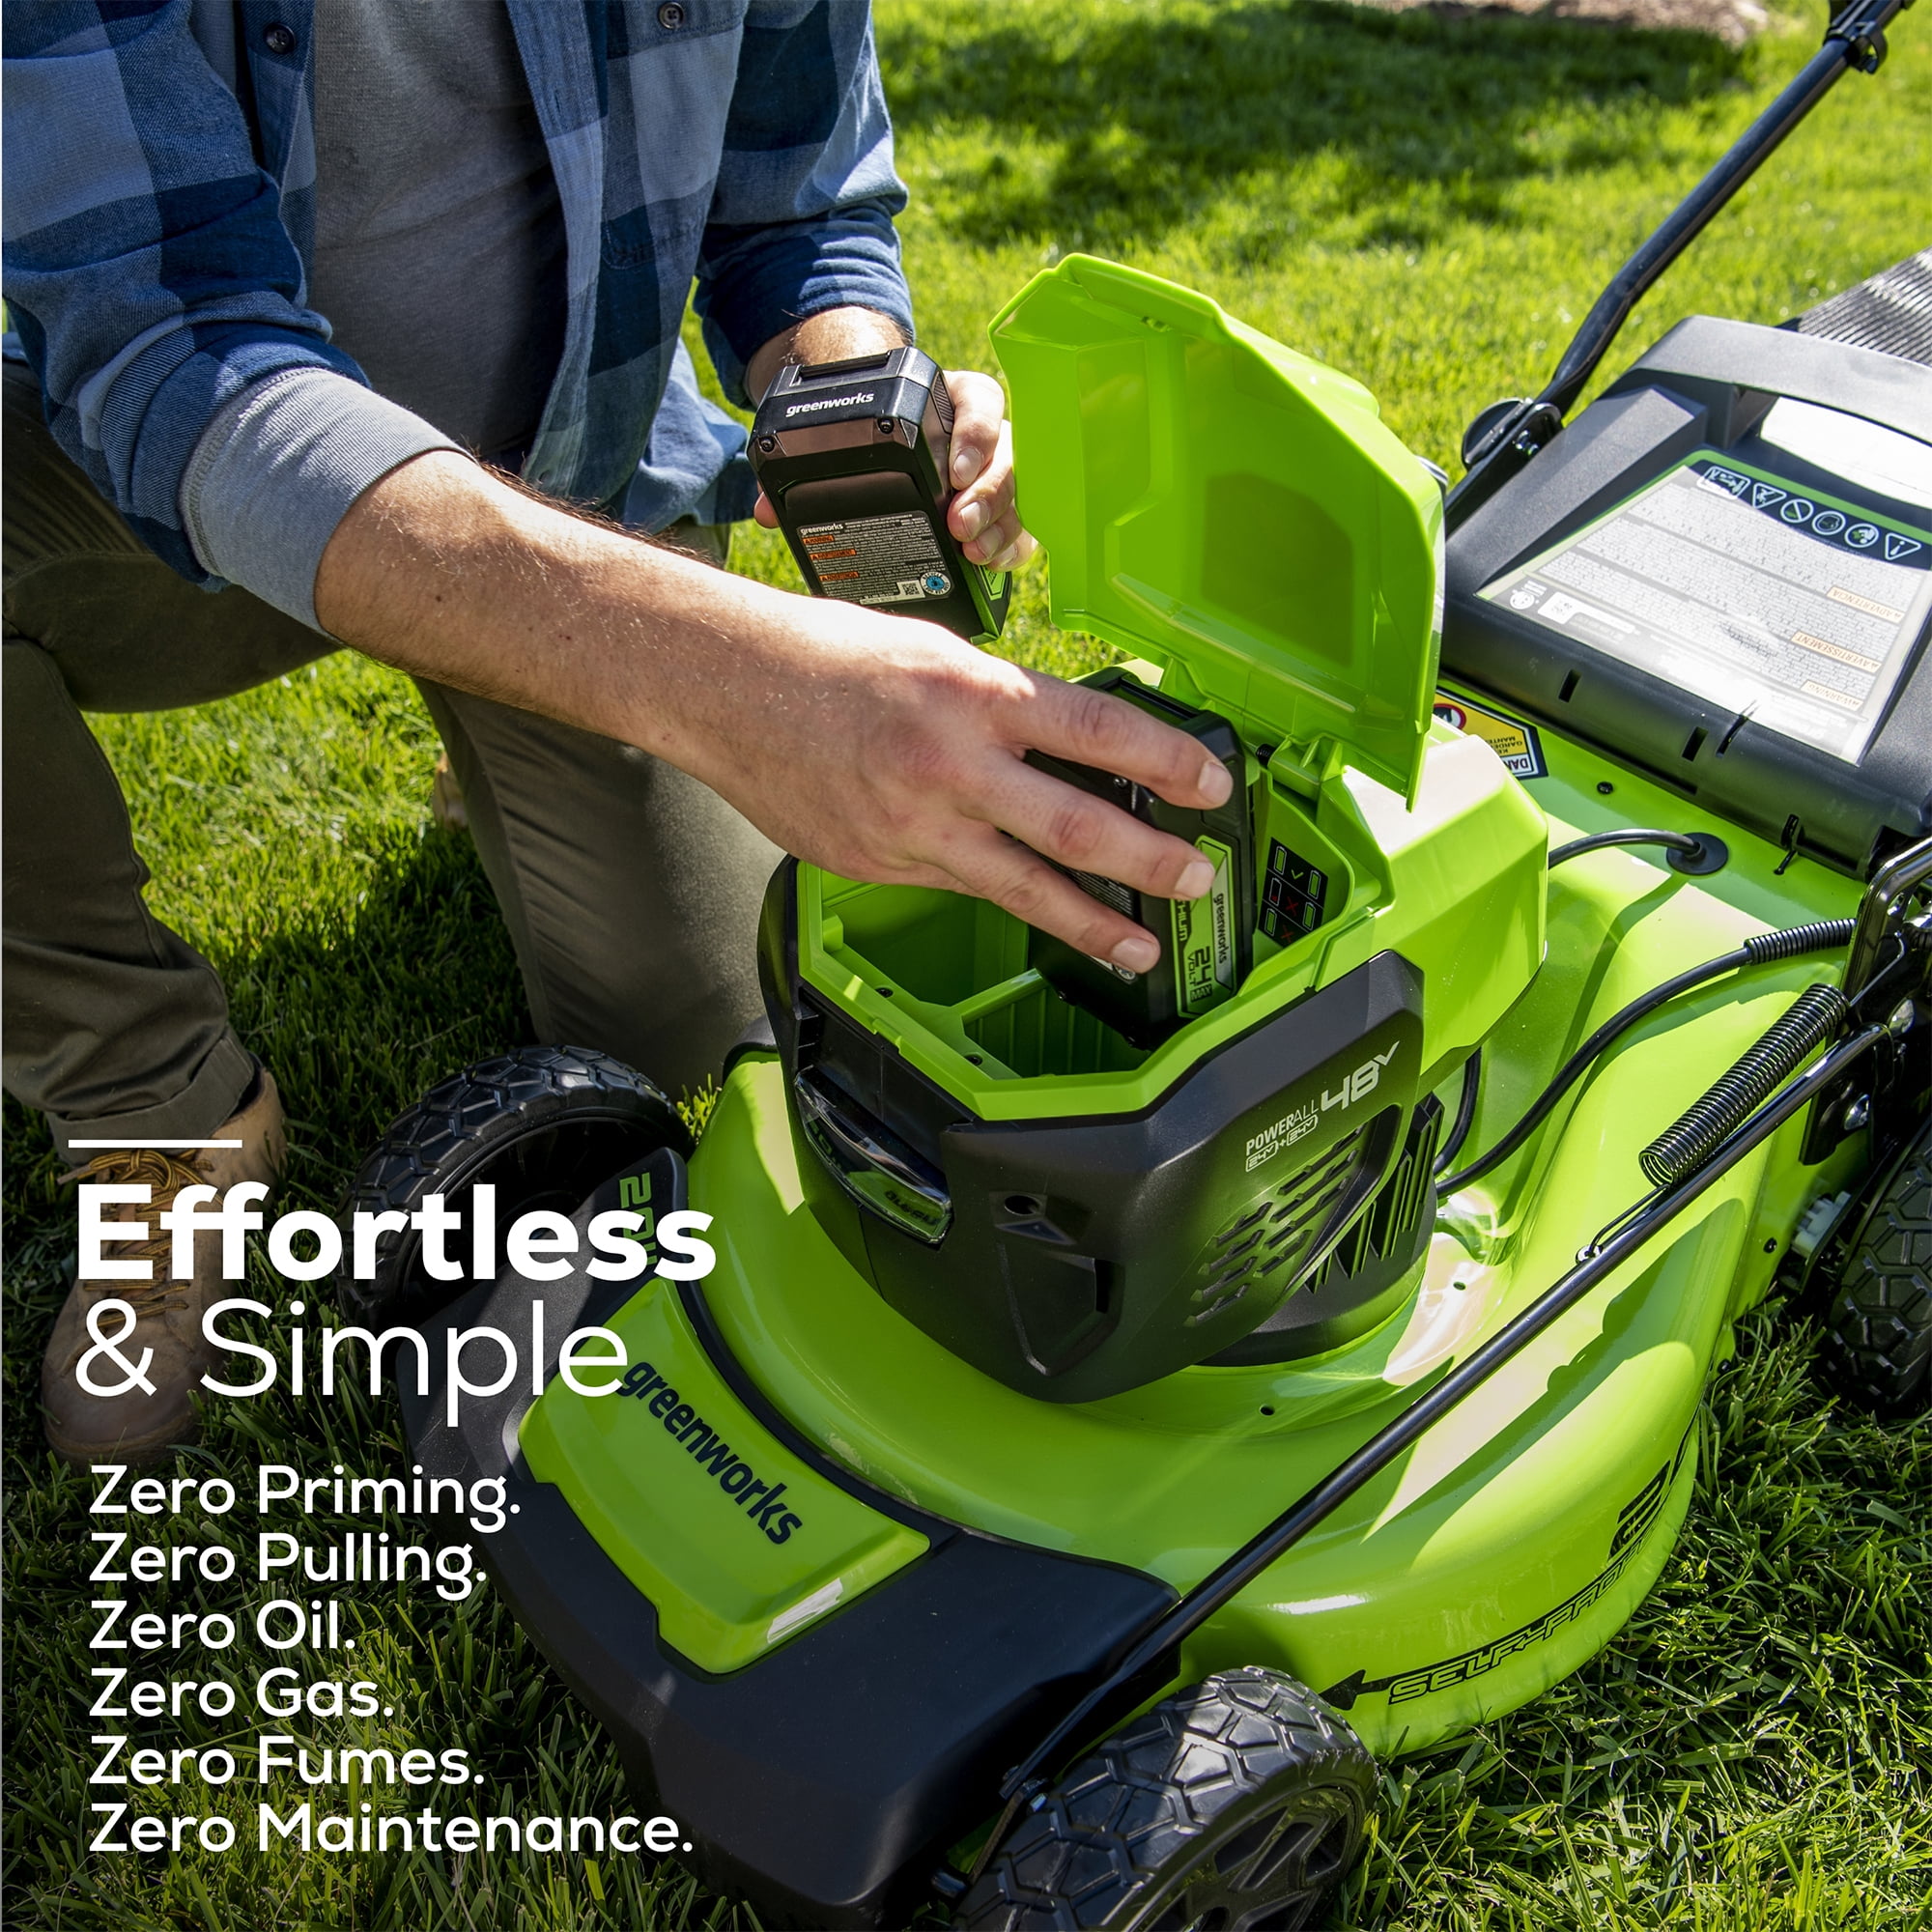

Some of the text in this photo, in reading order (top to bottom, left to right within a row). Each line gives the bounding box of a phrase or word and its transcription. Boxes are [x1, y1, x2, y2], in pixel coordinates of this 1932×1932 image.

[785, 392, 874, 417] greenworks
[800, 523, 844, 535] greenworks
[1797, 635, 1870, 668] AVERTISSEMENT
[1503, 757, 1529, 770] DAN
[1213, 893, 1229, 964] greenworks
[1187, 952, 1197, 986] VOLT
[1195, 946, 1212, 986] 24
[1246, 1040, 1400, 1156] POWERALL 48V
[619, 1361, 803, 1545] greenworks
